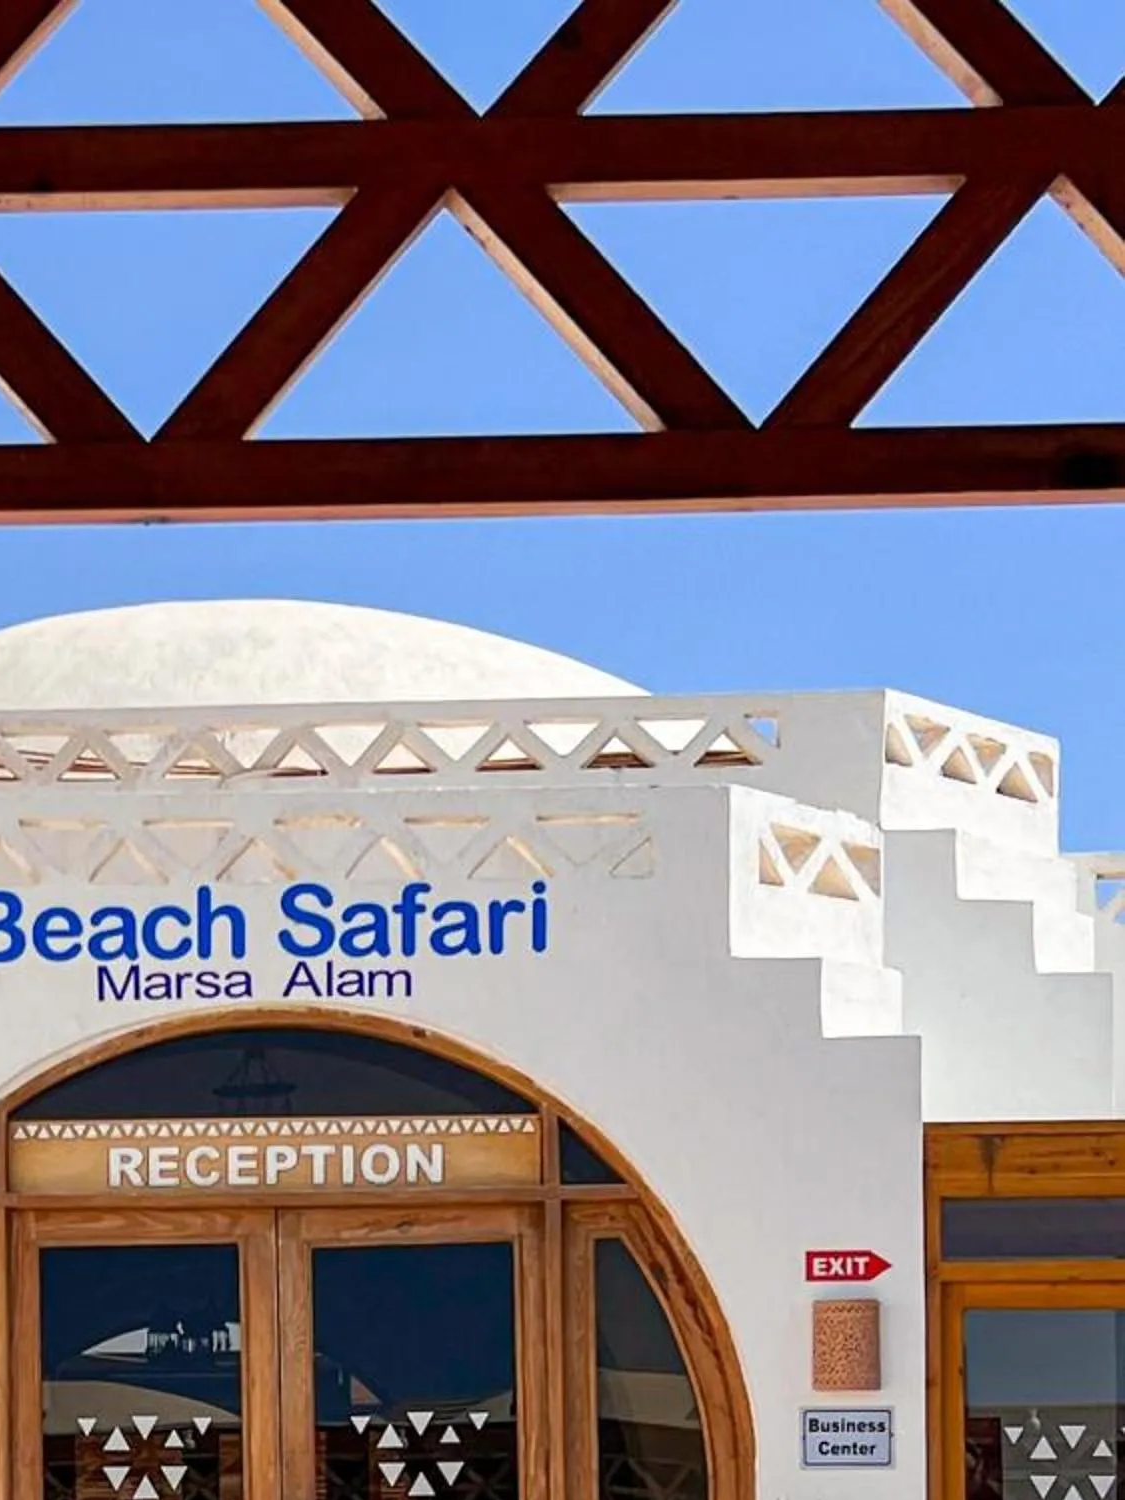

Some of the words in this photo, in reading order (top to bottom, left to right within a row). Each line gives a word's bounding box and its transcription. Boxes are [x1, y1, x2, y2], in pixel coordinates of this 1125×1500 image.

[278, 881, 548, 959] Safari
[97, 965, 253, 1001] Marsa
[282, 961, 413, 997] Alam
[107, 1143, 445, 1187] RECEPTION
[812, 1257, 870, 1276] EXIT
[809, 1418, 886, 1433] Business
[818, 1441, 876, 1456] Center
